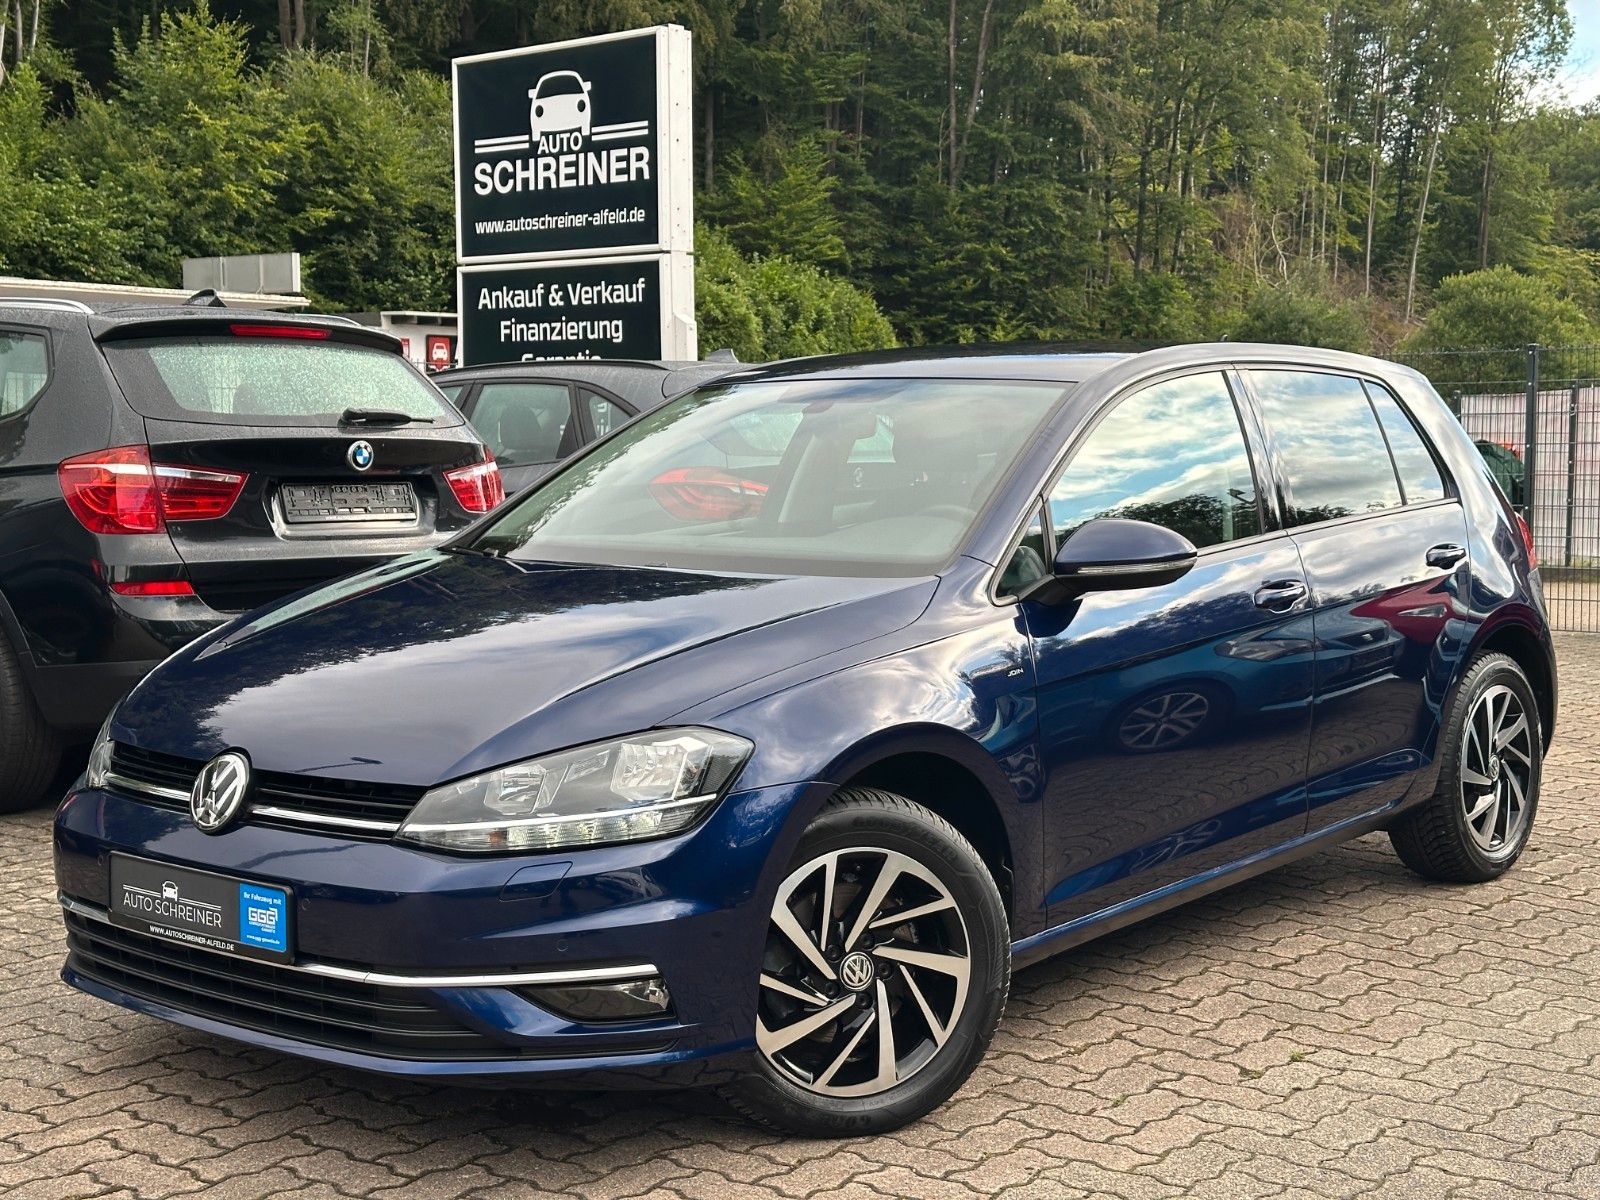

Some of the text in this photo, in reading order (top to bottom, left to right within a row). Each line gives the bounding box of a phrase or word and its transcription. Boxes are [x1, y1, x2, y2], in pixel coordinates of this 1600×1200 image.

[537, 131, 583, 155] AUTO
[474, 146, 650, 195] SCHREINER
[475, 206, 646, 234] www.autoschreiner-alfeld.de
[478, 277, 646, 310] Ankauf & Verkauf
[500, 316, 623, 343] Finanzierung
[1007, 667, 1024, 677] JOIN
[123, 892, 153, 912] AUTO
[155, 901, 222, 928] SCHREINER
[149, 925, 235, 951] WWW.AUTOSCHREINER-ALFELD.DE
